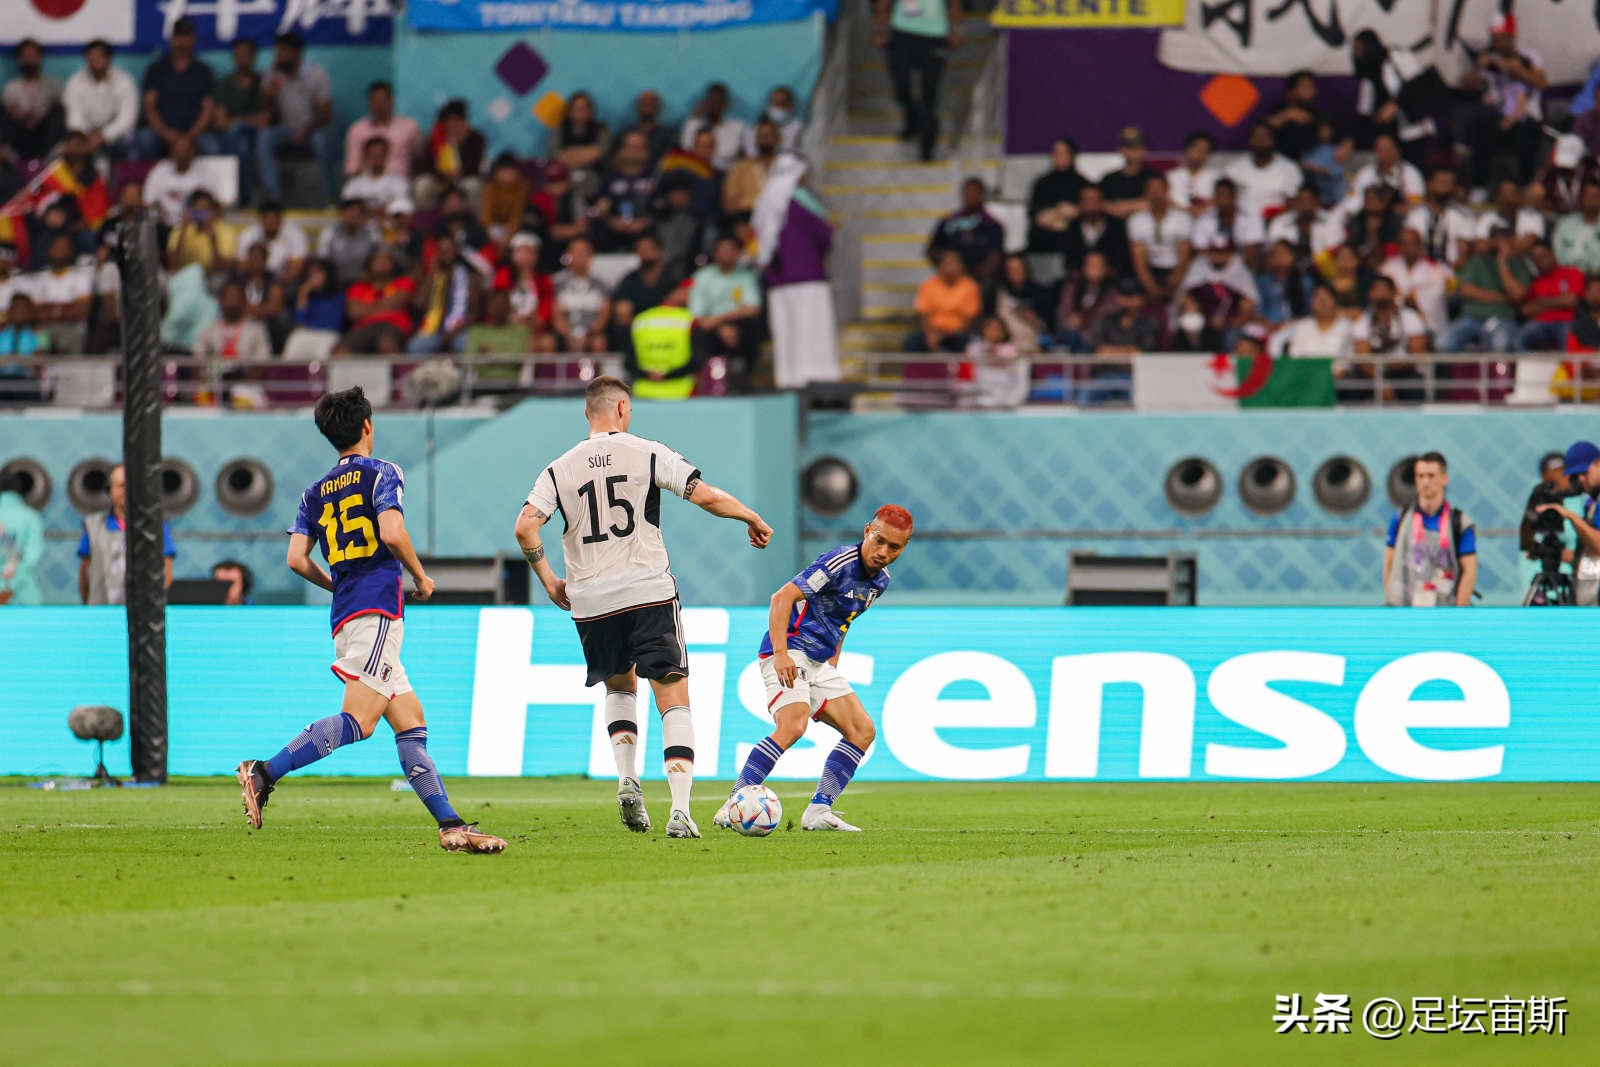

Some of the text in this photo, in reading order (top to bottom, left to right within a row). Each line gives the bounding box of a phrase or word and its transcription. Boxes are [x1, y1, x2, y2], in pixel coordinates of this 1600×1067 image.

[320, 470, 361, 498] KAMADA
[588, 454, 612, 469] SÜLE
[318, 493, 379, 566] 15
[577, 474, 636, 545] 15
[467, 607, 1511, 781] Hisense
